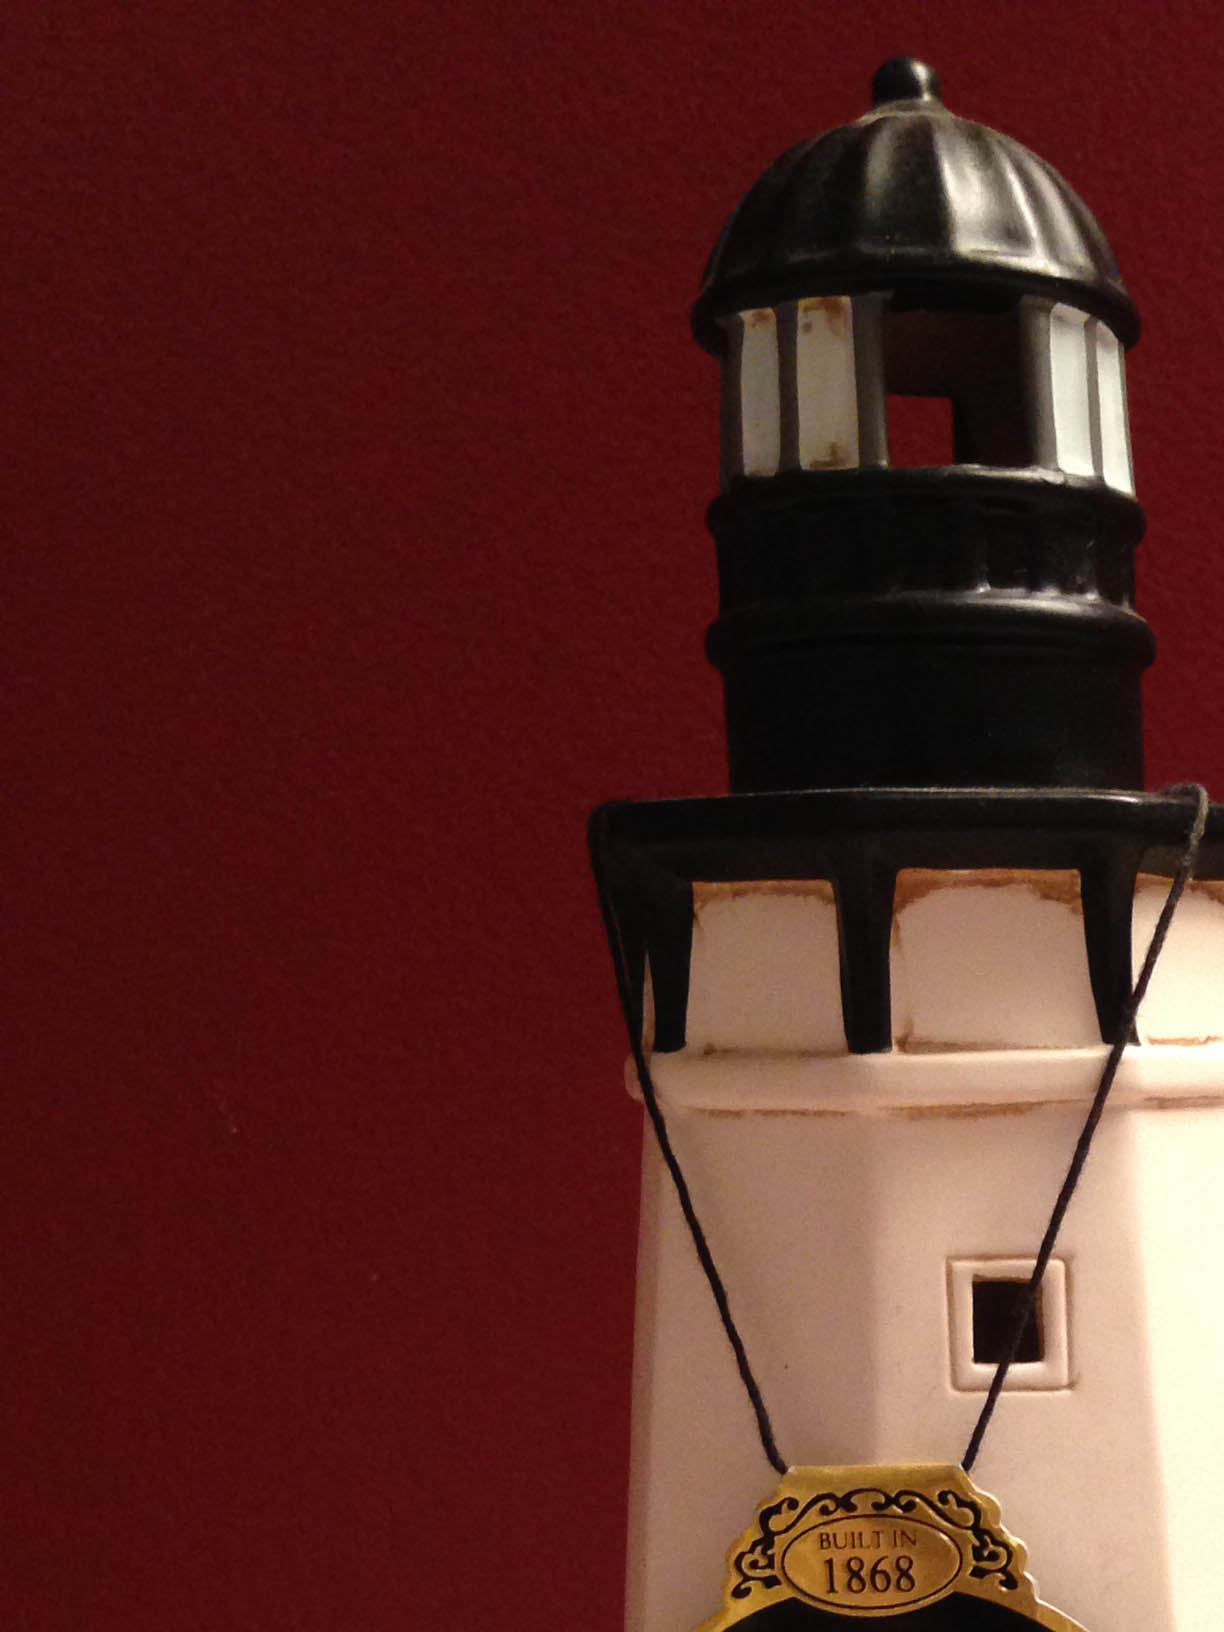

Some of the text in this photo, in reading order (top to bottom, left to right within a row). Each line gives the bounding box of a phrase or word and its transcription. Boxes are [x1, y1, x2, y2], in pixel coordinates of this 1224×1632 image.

[820, 1529, 917, 1550] BUILT IN
[823, 1555, 916, 1594] 1868
